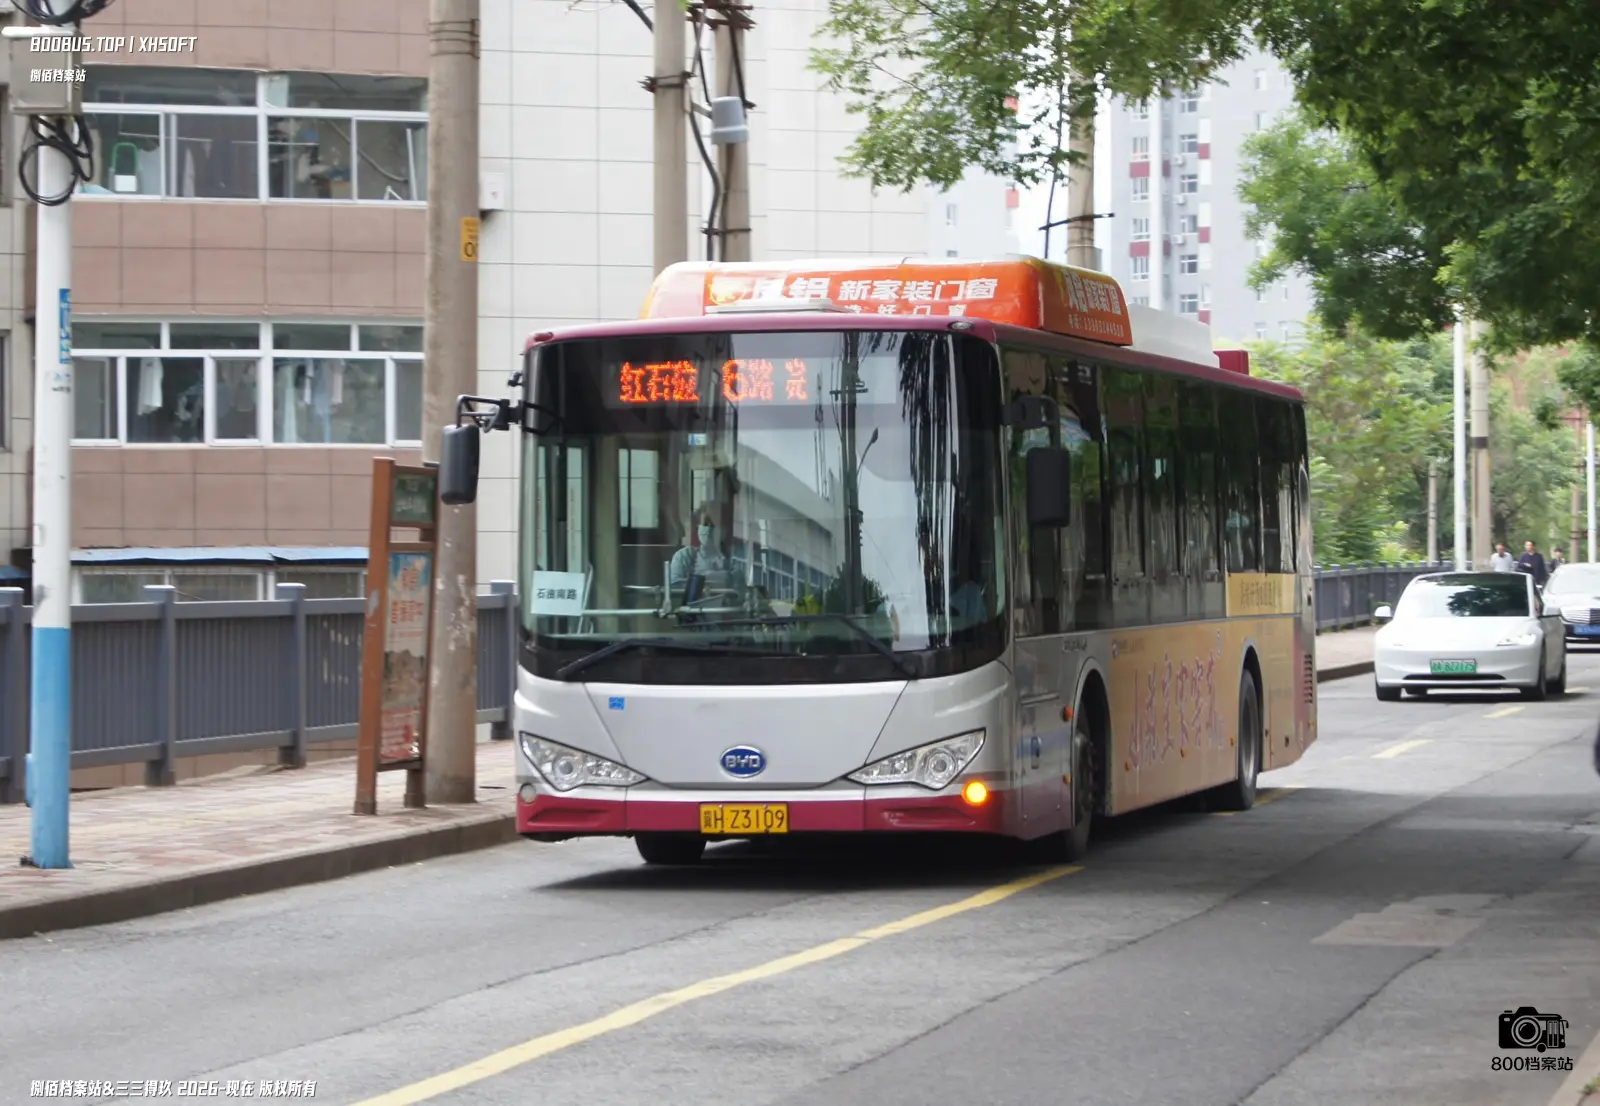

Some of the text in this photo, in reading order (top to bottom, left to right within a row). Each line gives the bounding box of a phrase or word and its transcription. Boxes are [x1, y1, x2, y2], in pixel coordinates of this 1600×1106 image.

[838, 278, 998, 301] 新家装门窗
[536, 588, 578, 601] 石油南路
[725, 754, 761, 768] BYD
